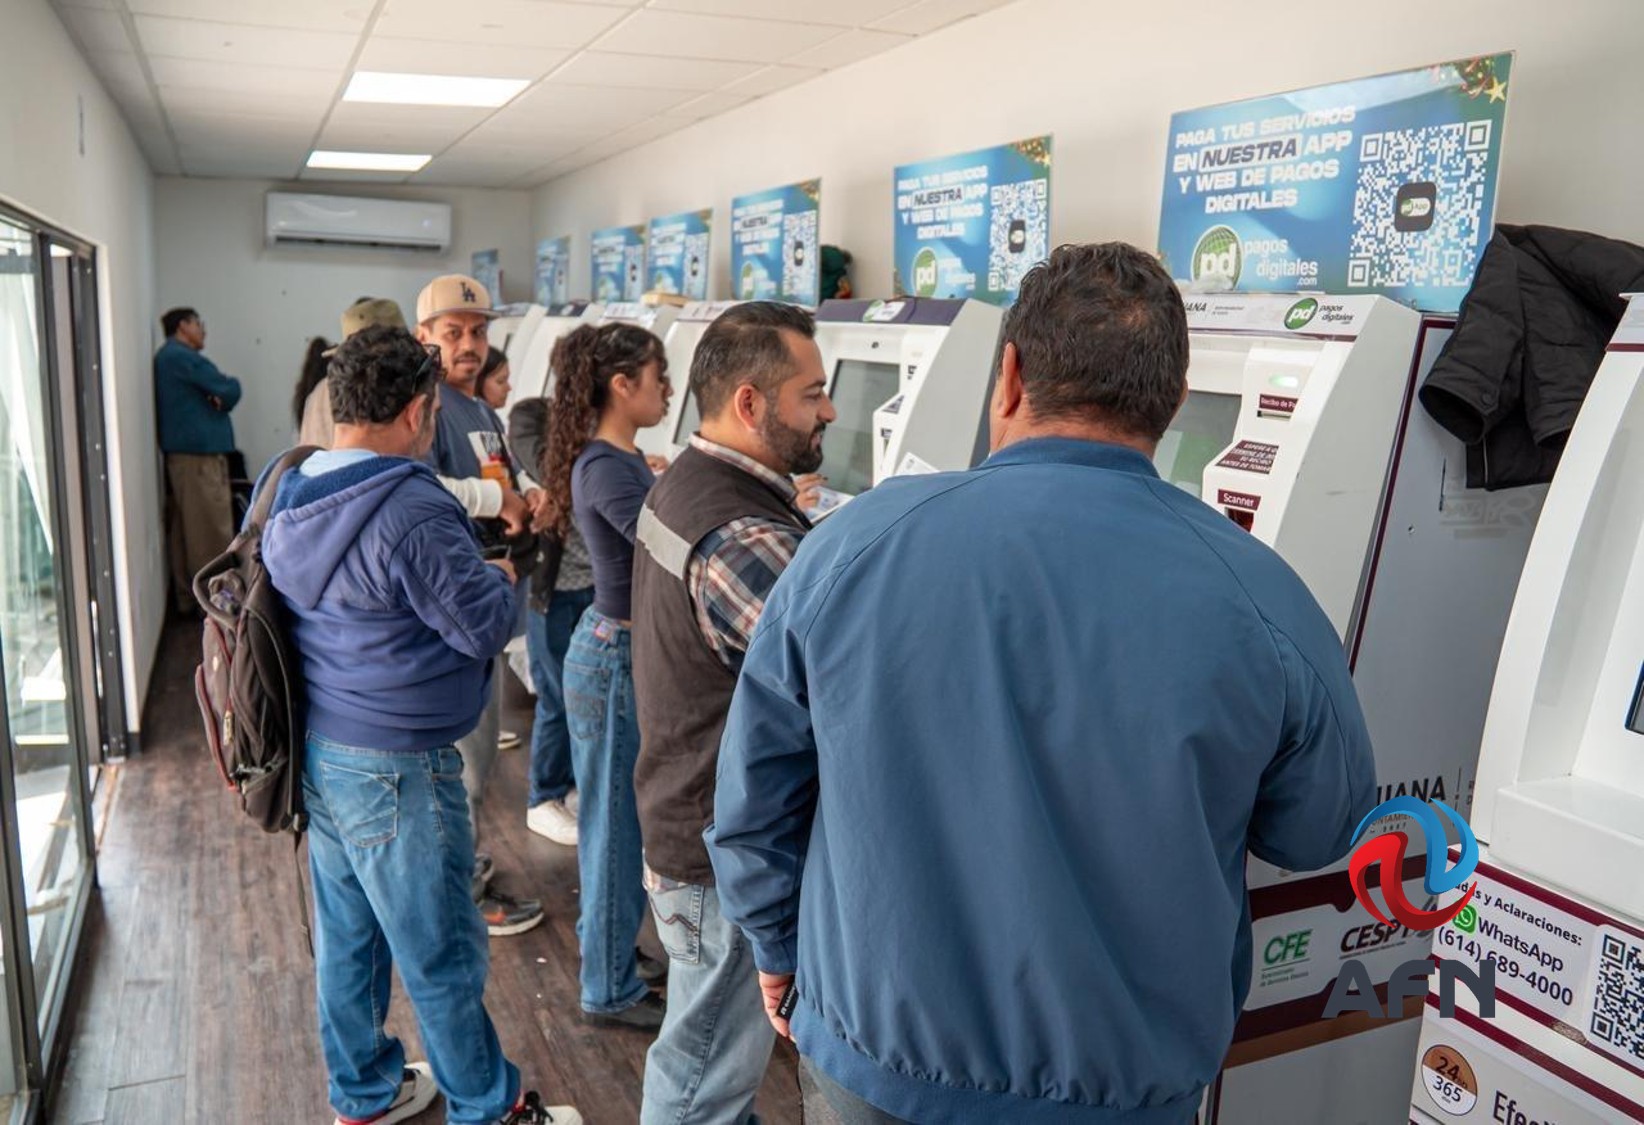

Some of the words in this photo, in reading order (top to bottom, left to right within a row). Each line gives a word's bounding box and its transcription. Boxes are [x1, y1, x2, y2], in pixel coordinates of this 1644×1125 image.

[1175, 128, 1216, 148] PAGA
[1221, 121, 1255, 141] TUS
[1260, 105, 1356, 135] SERVICIOS
[1173, 152, 1199, 173] EN
[1201, 138, 1297, 168] NUESTRA
[1303, 130, 1353, 155] APP
[1179, 177, 1191, 194] Y
[1196, 170, 1237, 191] WEB
[1241, 167, 1265, 187] DE
[1270, 159, 1340, 183] PAGOS
[914, 188, 962, 206] NUESTRA
[1205, 188, 1298, 213] DIGITALES
[1243, 239, 1288, 258] pagos
[1256, 258, 1318, 280] digitales
[461, 282, 476, 302] LA
[1223, 492, 1255, 507] Scanner
[1484, 894, 1492, 906] y
[1494, 898, 1583, 946] Aclaraciones:
[1264, 929, 1312, 965] CFE
[1438, 926, 1482, 962] (614)
[1478, 916, 1564, 973] WhatsApp
[1436, 1056, 1460, 1081] 24
[1433, 1075, 1463, 1102] 365
